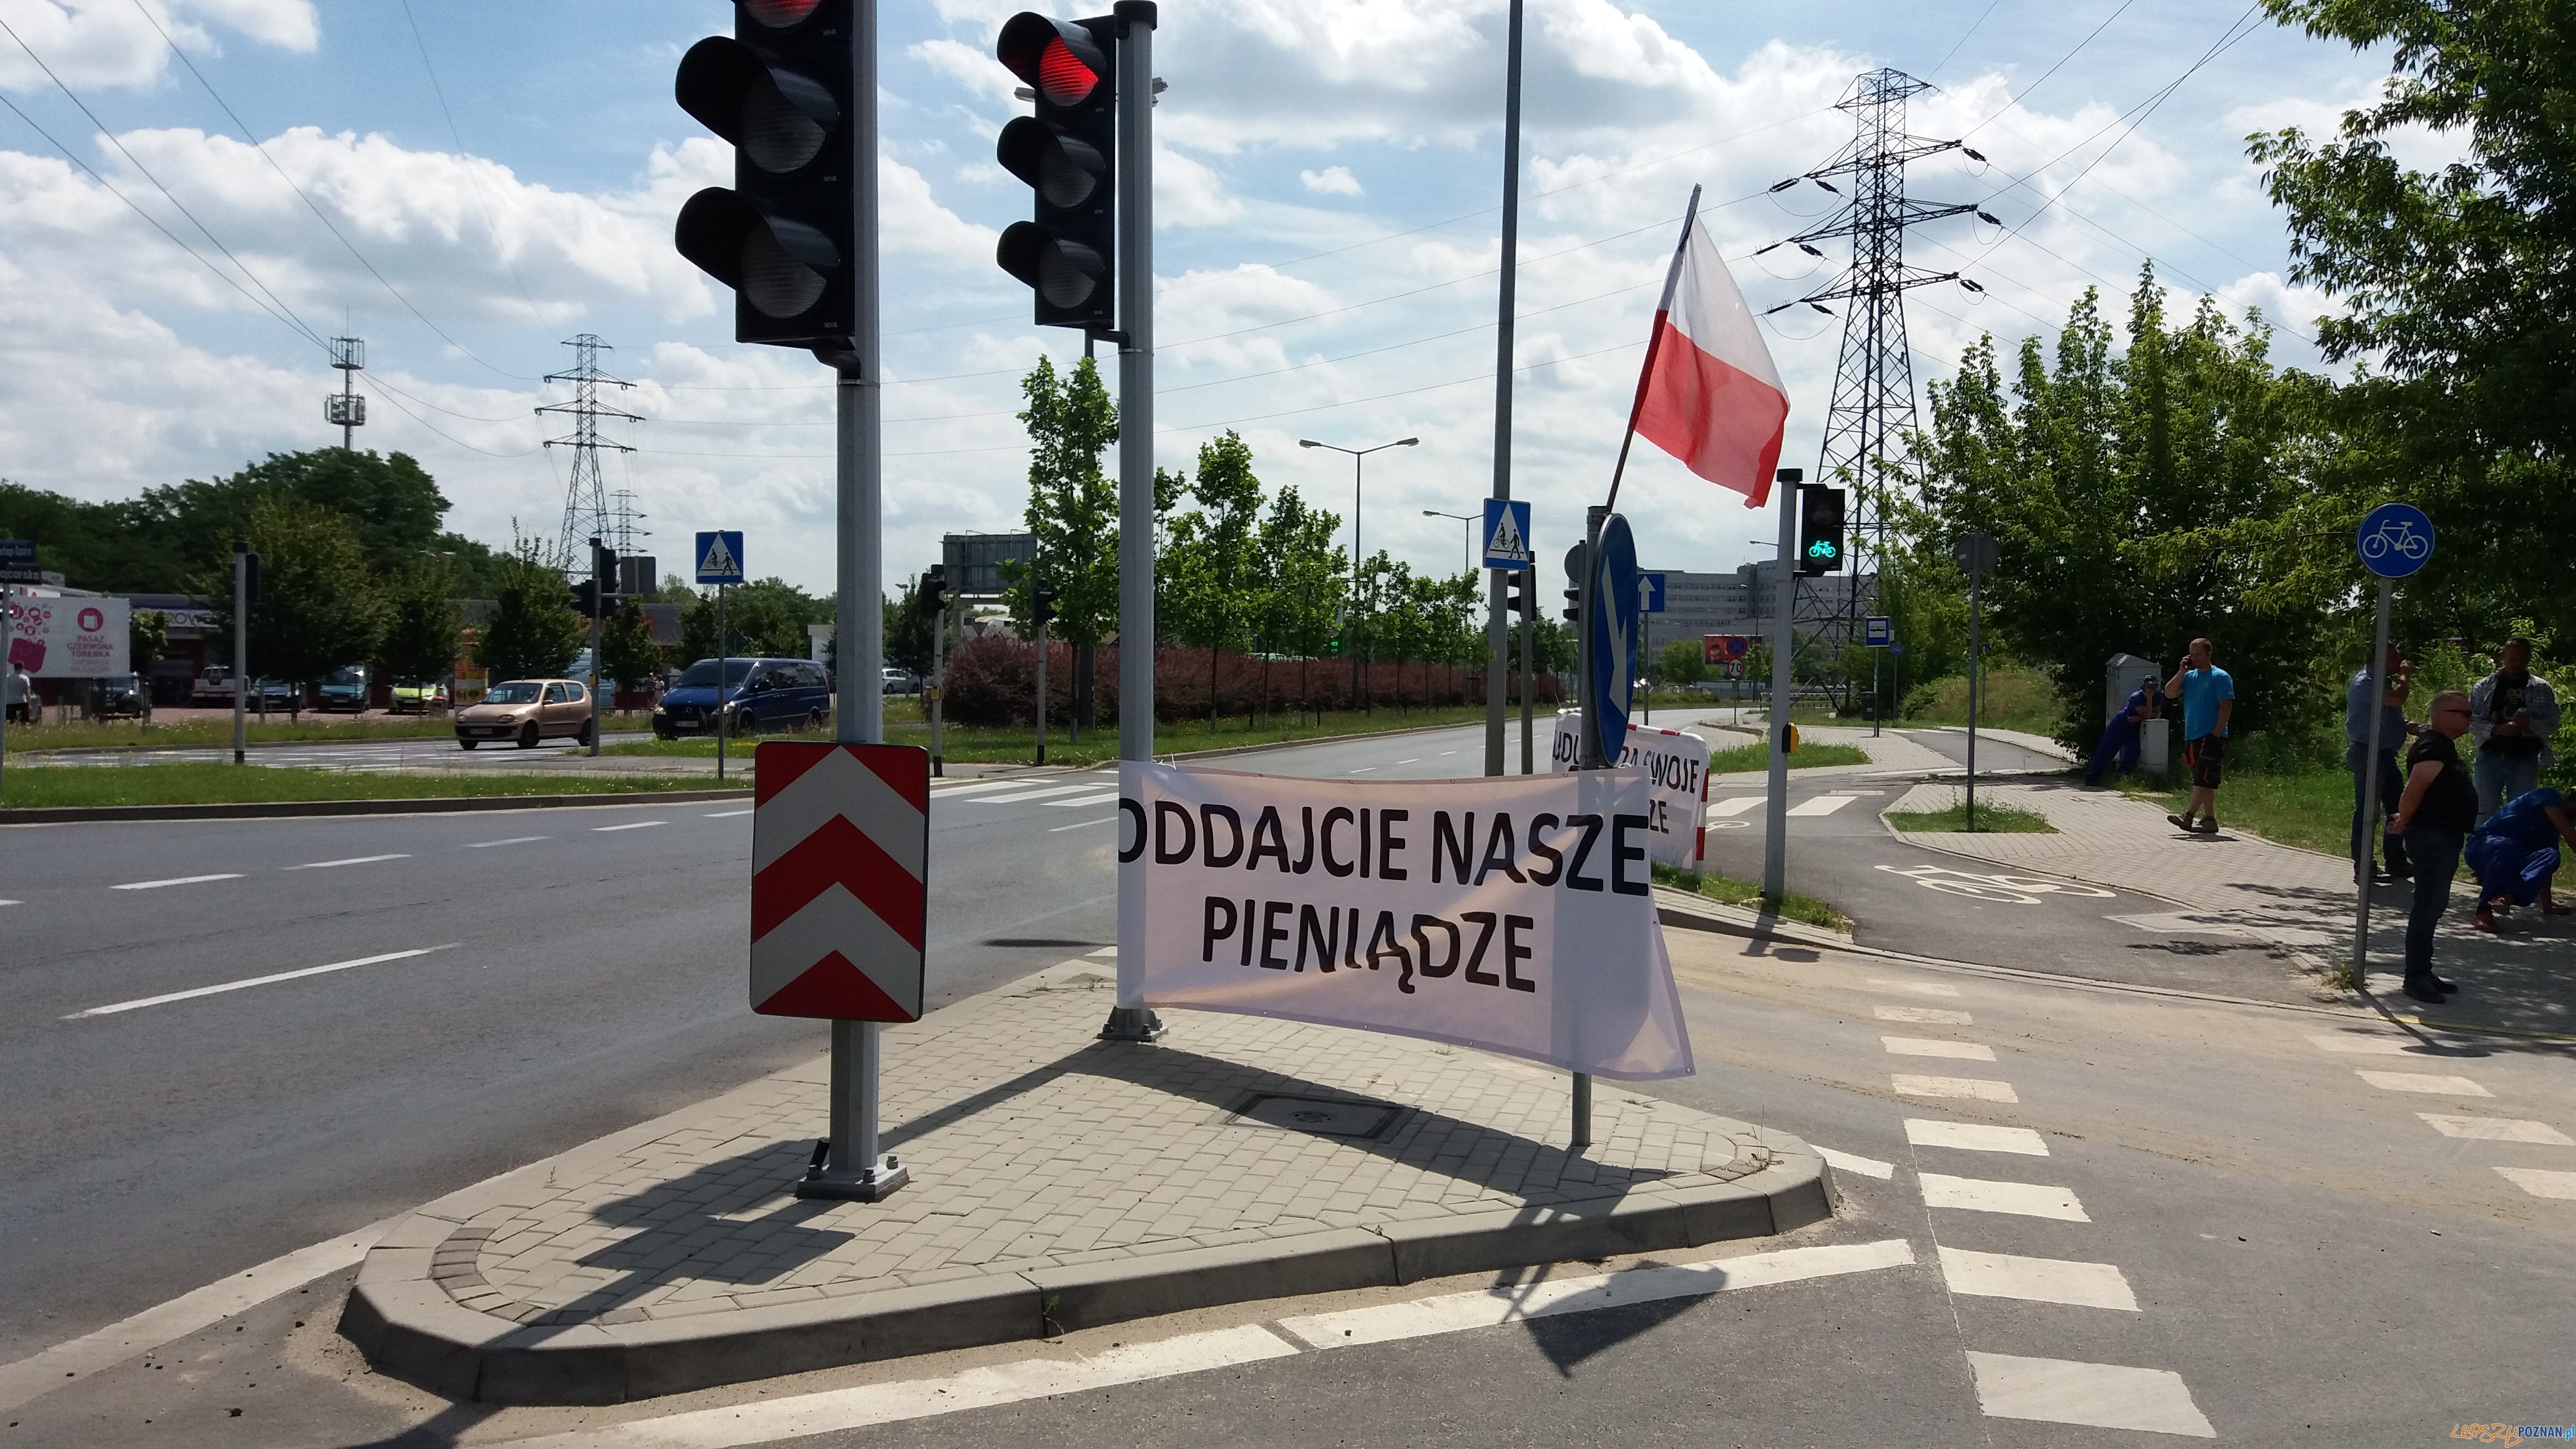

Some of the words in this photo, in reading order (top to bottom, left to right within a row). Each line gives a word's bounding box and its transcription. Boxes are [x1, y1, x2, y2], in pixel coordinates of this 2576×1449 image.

[1730, 663, 1742, 673] 70
[1118, 797, 1408, 881] ODDAJCIE
[1432, 811, 1649, 896] NASZE
[1203, 895, 1535, 994] PIENIĄDZE
